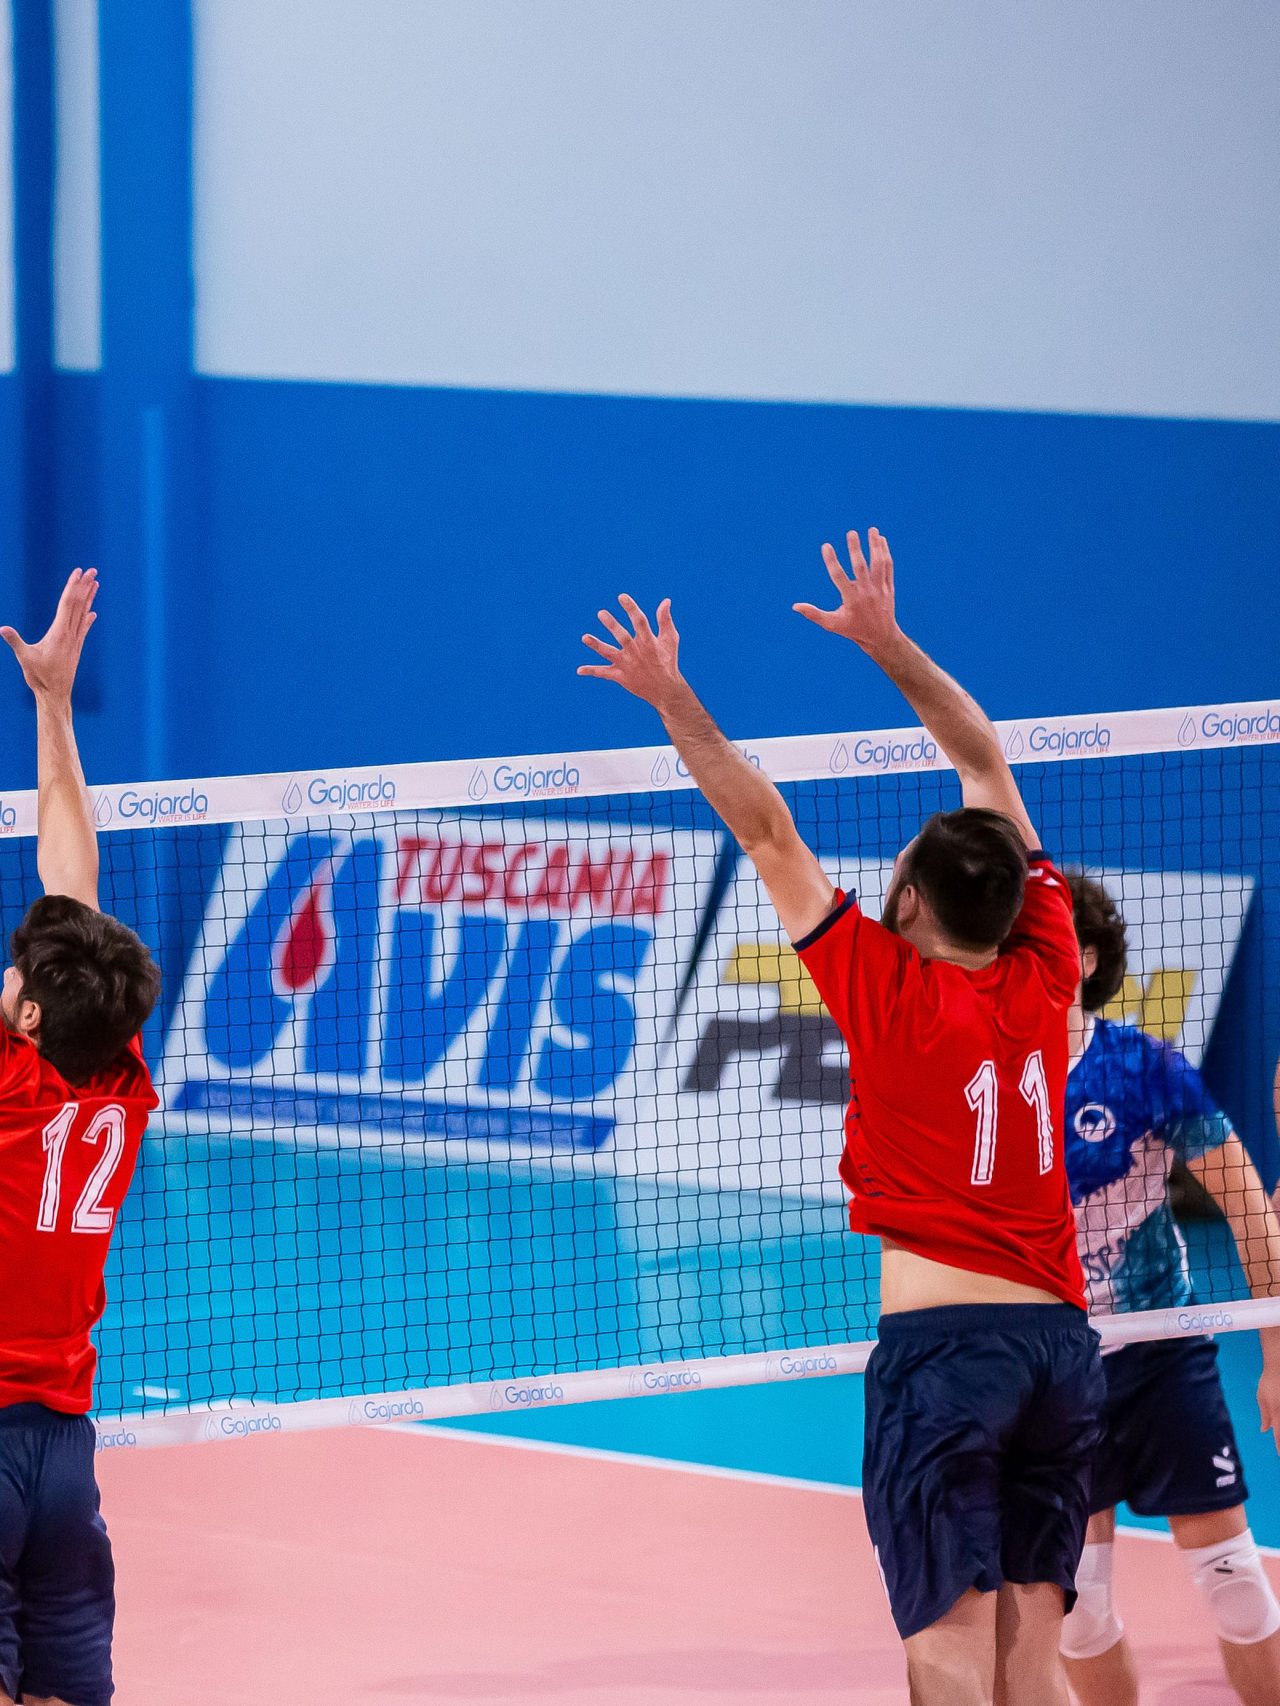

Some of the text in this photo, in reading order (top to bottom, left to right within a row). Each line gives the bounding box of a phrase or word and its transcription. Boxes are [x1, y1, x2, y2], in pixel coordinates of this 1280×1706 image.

[1030, 722, 1111, 756] Gajarda
[1202, 709, 1280, 742] Gajarda
[855, 736, 937, 769] Gajarda
[308, 774, 396, 810] Gajarda
[494, 762, 580, 796] Gajarda
[119, 788, 208, 823] Gajarda
[157, 815, 184, 823] WATER
[393, 837, 671, 917] TUSCANIA
[203, 834, 655, 1102] AVIS
[964, 1051, 1053, 1185] 11
[36, 1102, 127, 1233] 12
[1178, 1311, 1233, 1332] Gajarda
[644, 1368, 702, 1391] Gajarda
[780, 1352, 838, 1376] Gajarda
[363, 1397, 424, 1420] Gajarda
[504, 1381, 564, 1405] Gajarda
[220, 1413, 282, 1436] Gajarda
